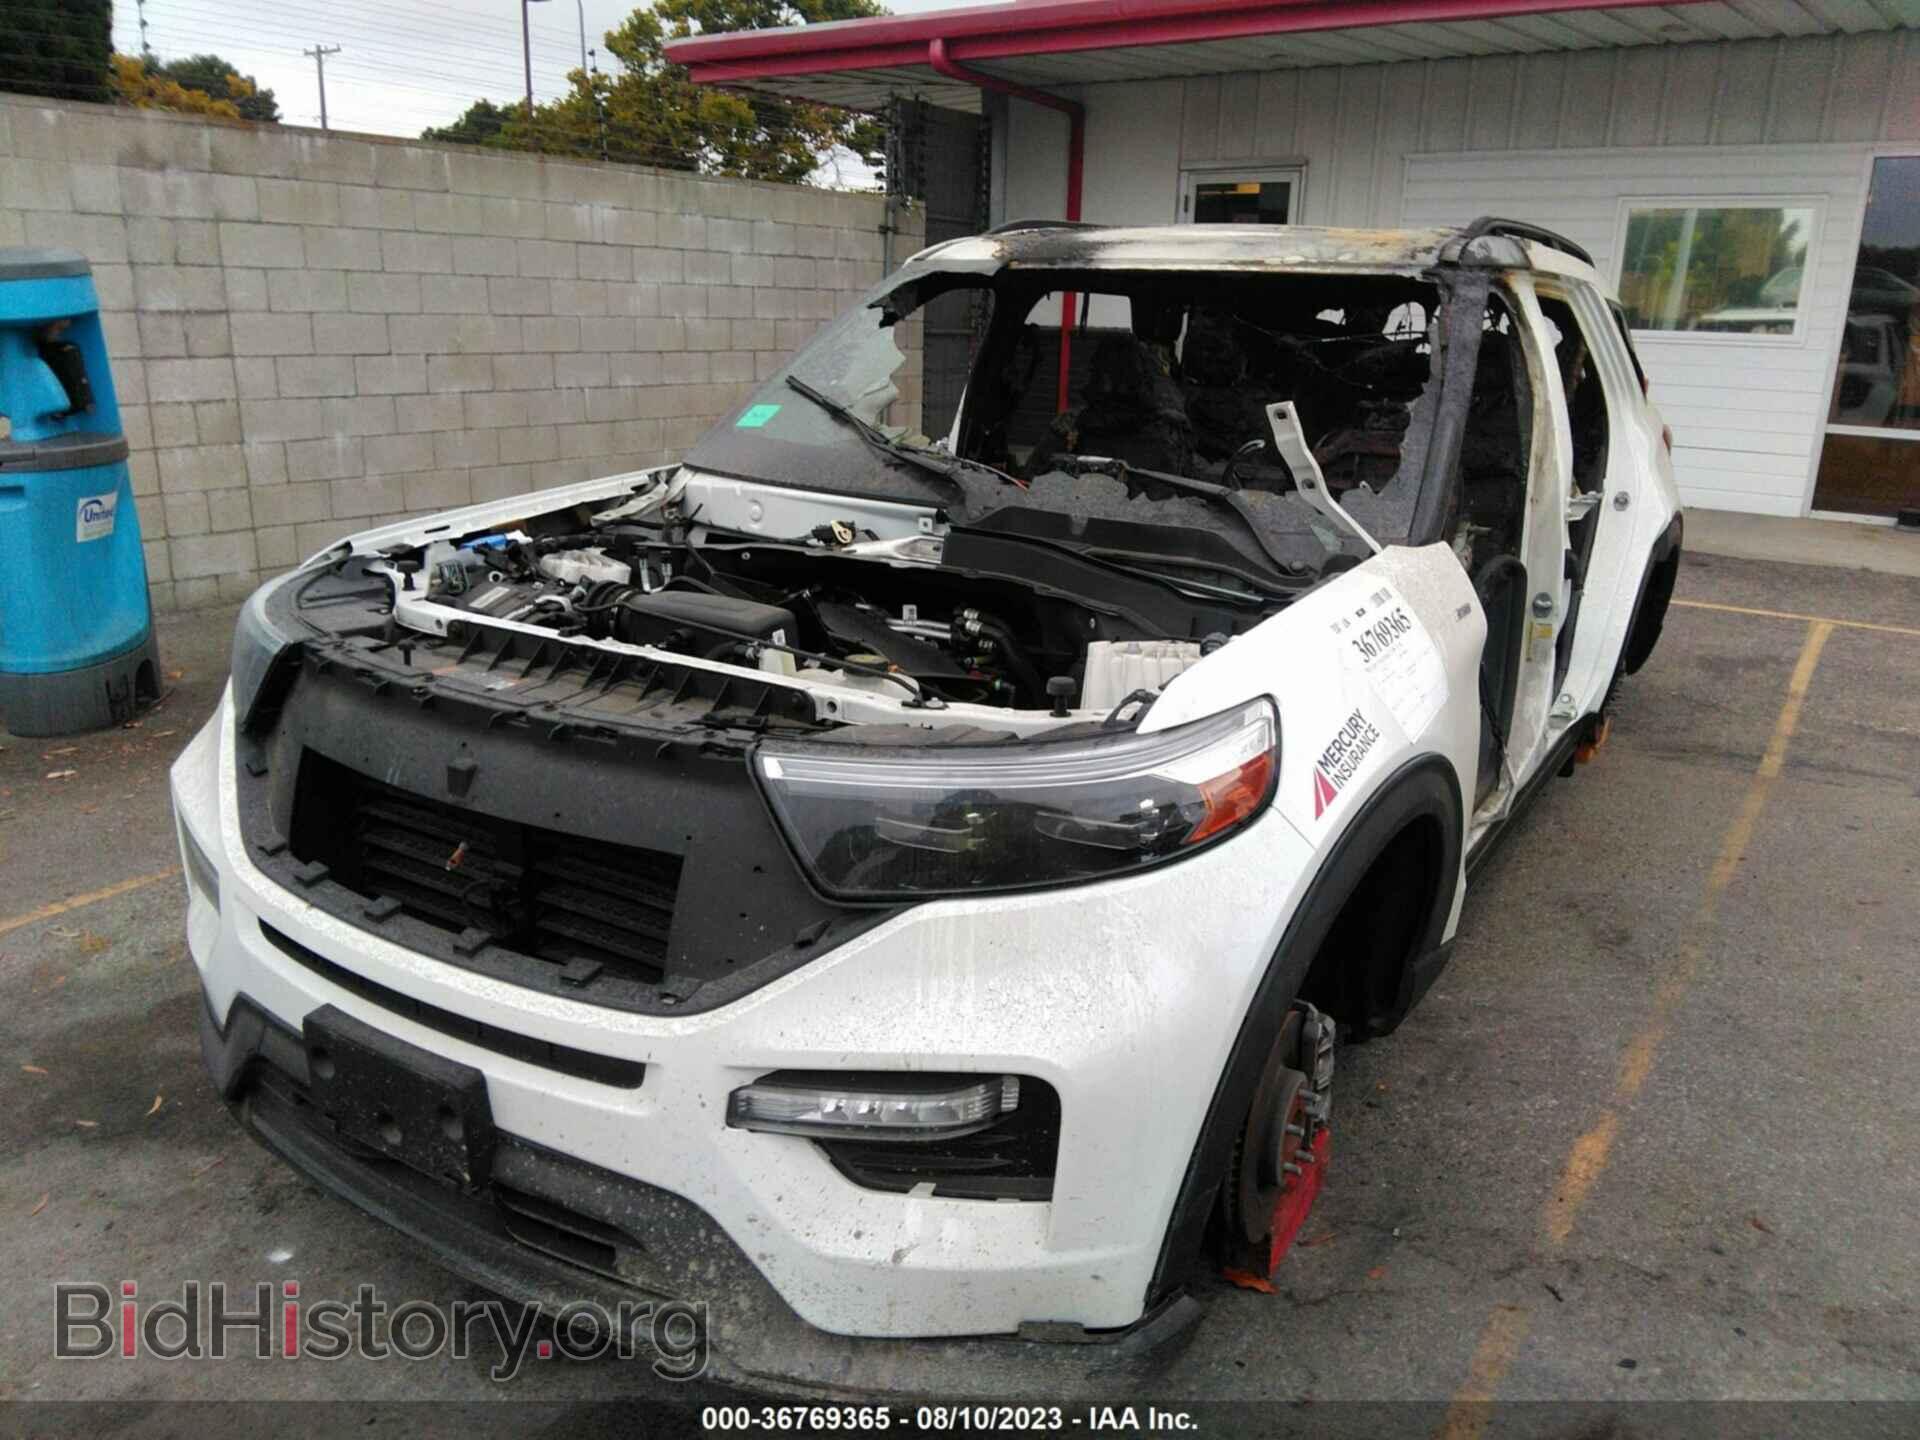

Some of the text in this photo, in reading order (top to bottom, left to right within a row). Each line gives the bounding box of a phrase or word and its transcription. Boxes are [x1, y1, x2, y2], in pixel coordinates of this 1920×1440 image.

[1352, 607, 1411, 663] 36769365
[1317, 707, 1367, 775] MERCURY
[1331, 723, 1380, 790] INSURANCE
